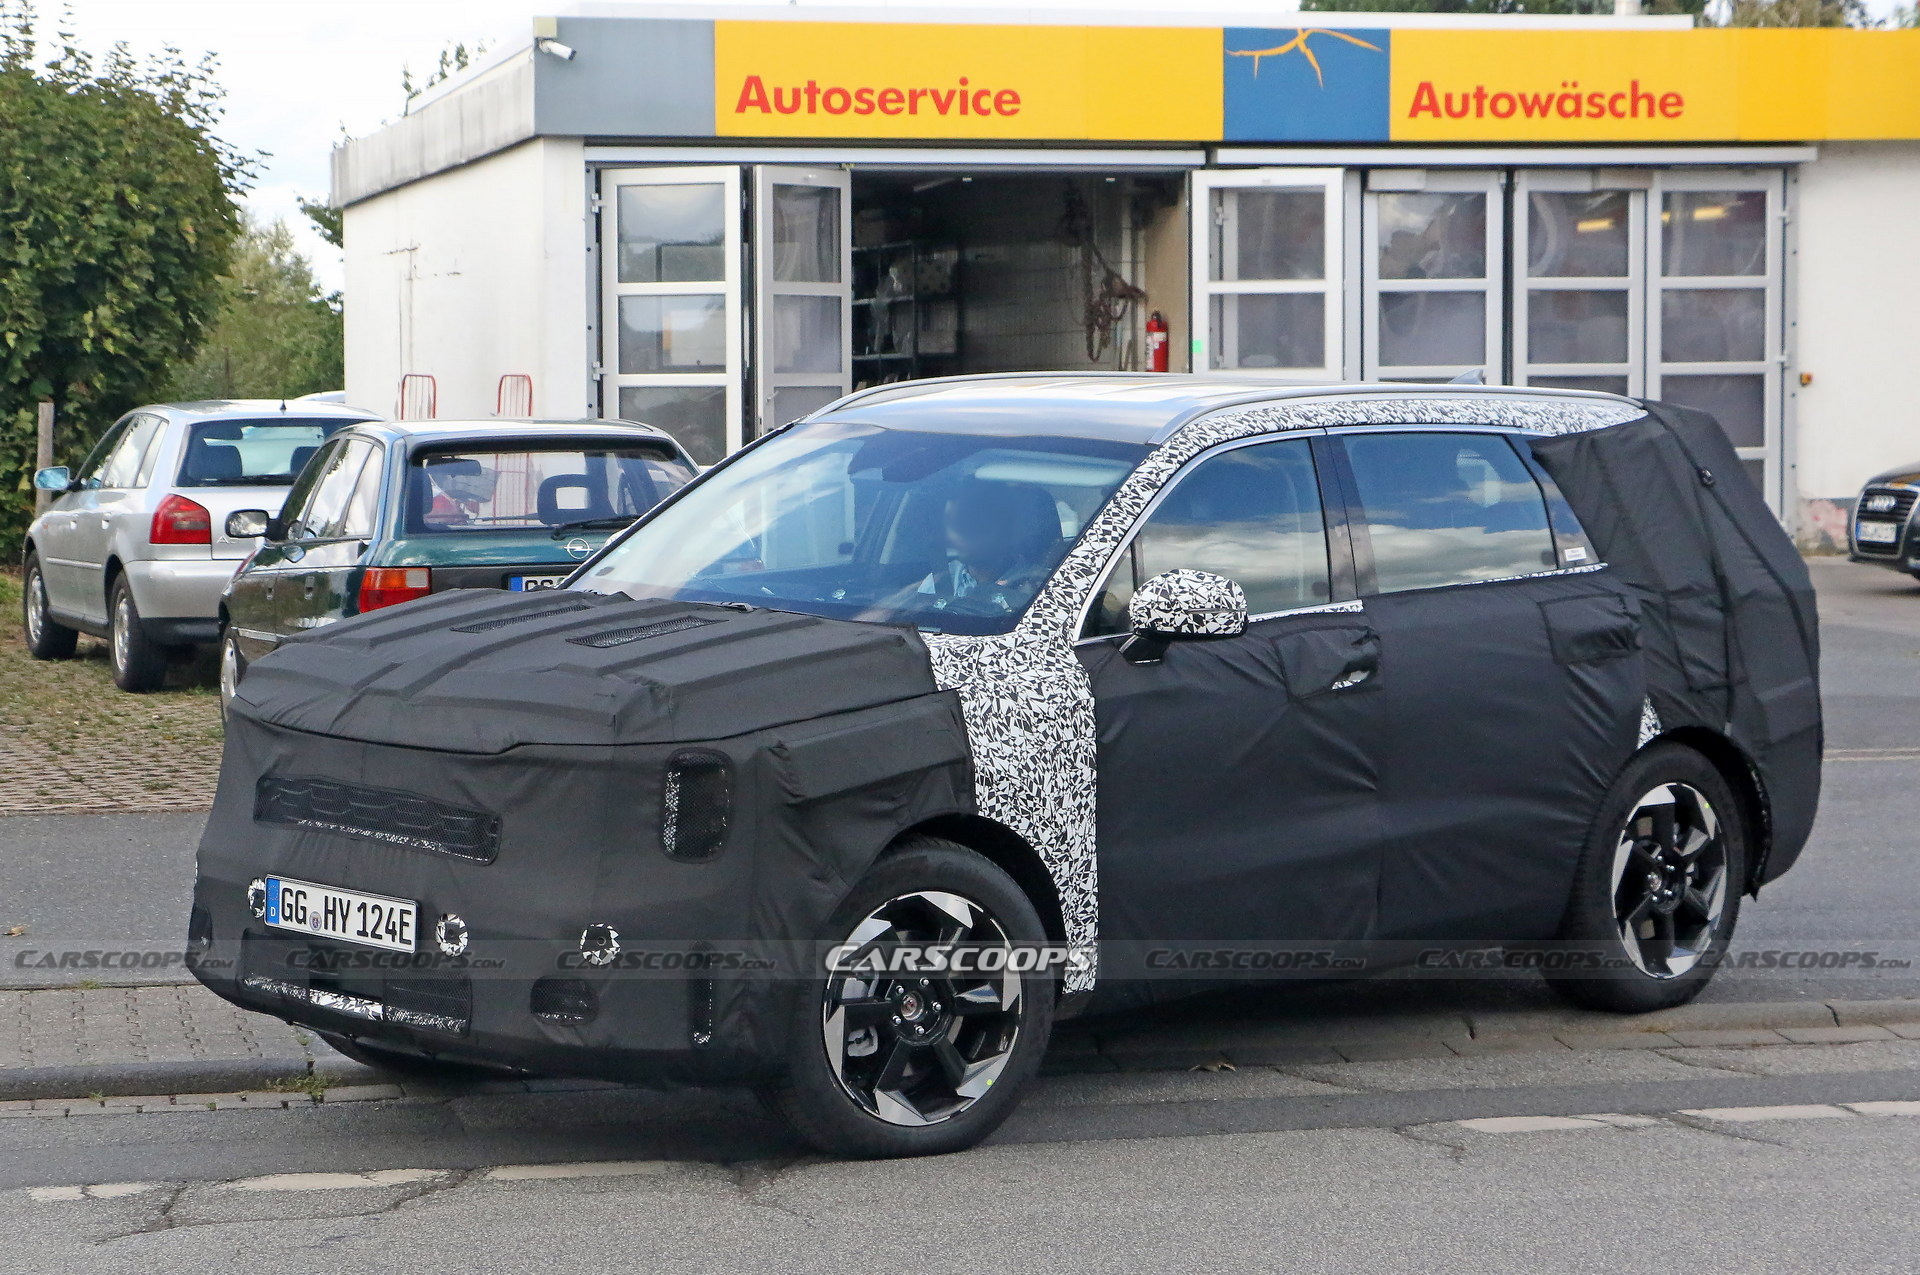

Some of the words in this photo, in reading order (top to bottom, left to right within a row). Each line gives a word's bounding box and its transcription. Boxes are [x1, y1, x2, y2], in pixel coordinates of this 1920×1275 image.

[735, 75, 1021, 116] Autoservice
[1408, 79, 1685, 119] Autowäsche
[269, 906, 276, 917] D
[281, 887, 308, 926] GG
[323, 895, 351, 934] HY
[356, 901, 413, 946] 124E
